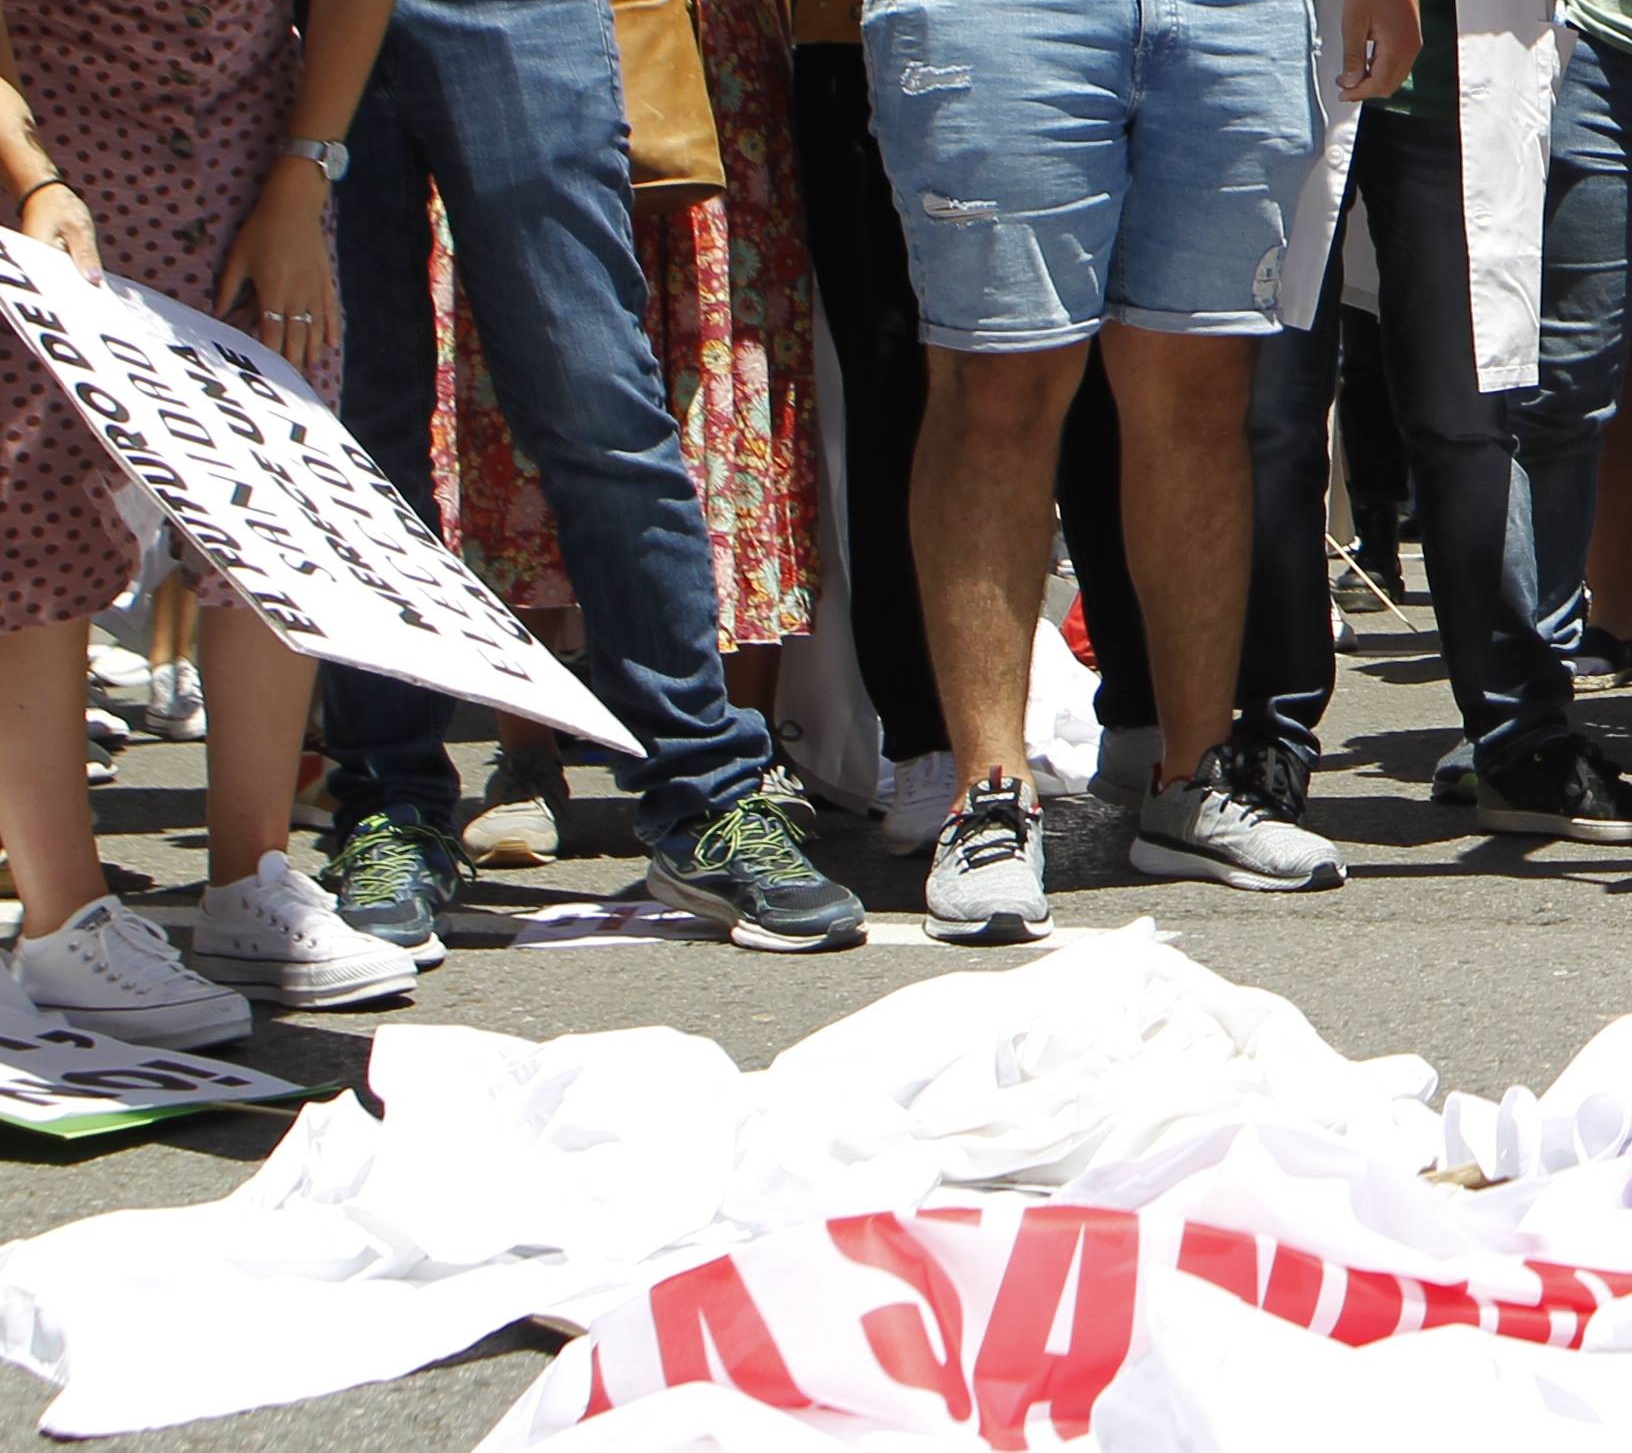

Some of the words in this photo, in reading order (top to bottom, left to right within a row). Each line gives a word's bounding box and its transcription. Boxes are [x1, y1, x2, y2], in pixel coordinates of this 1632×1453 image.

[19, 302, 96, 373] DE
[166, 344, 271, 445] UNA
[212, 341, 288, 405] DE
[74, 381, 268, 578] FUTURO
[101, 334, 337, 584] SANIDAD
[258, 448, 440, 635] MERECE
